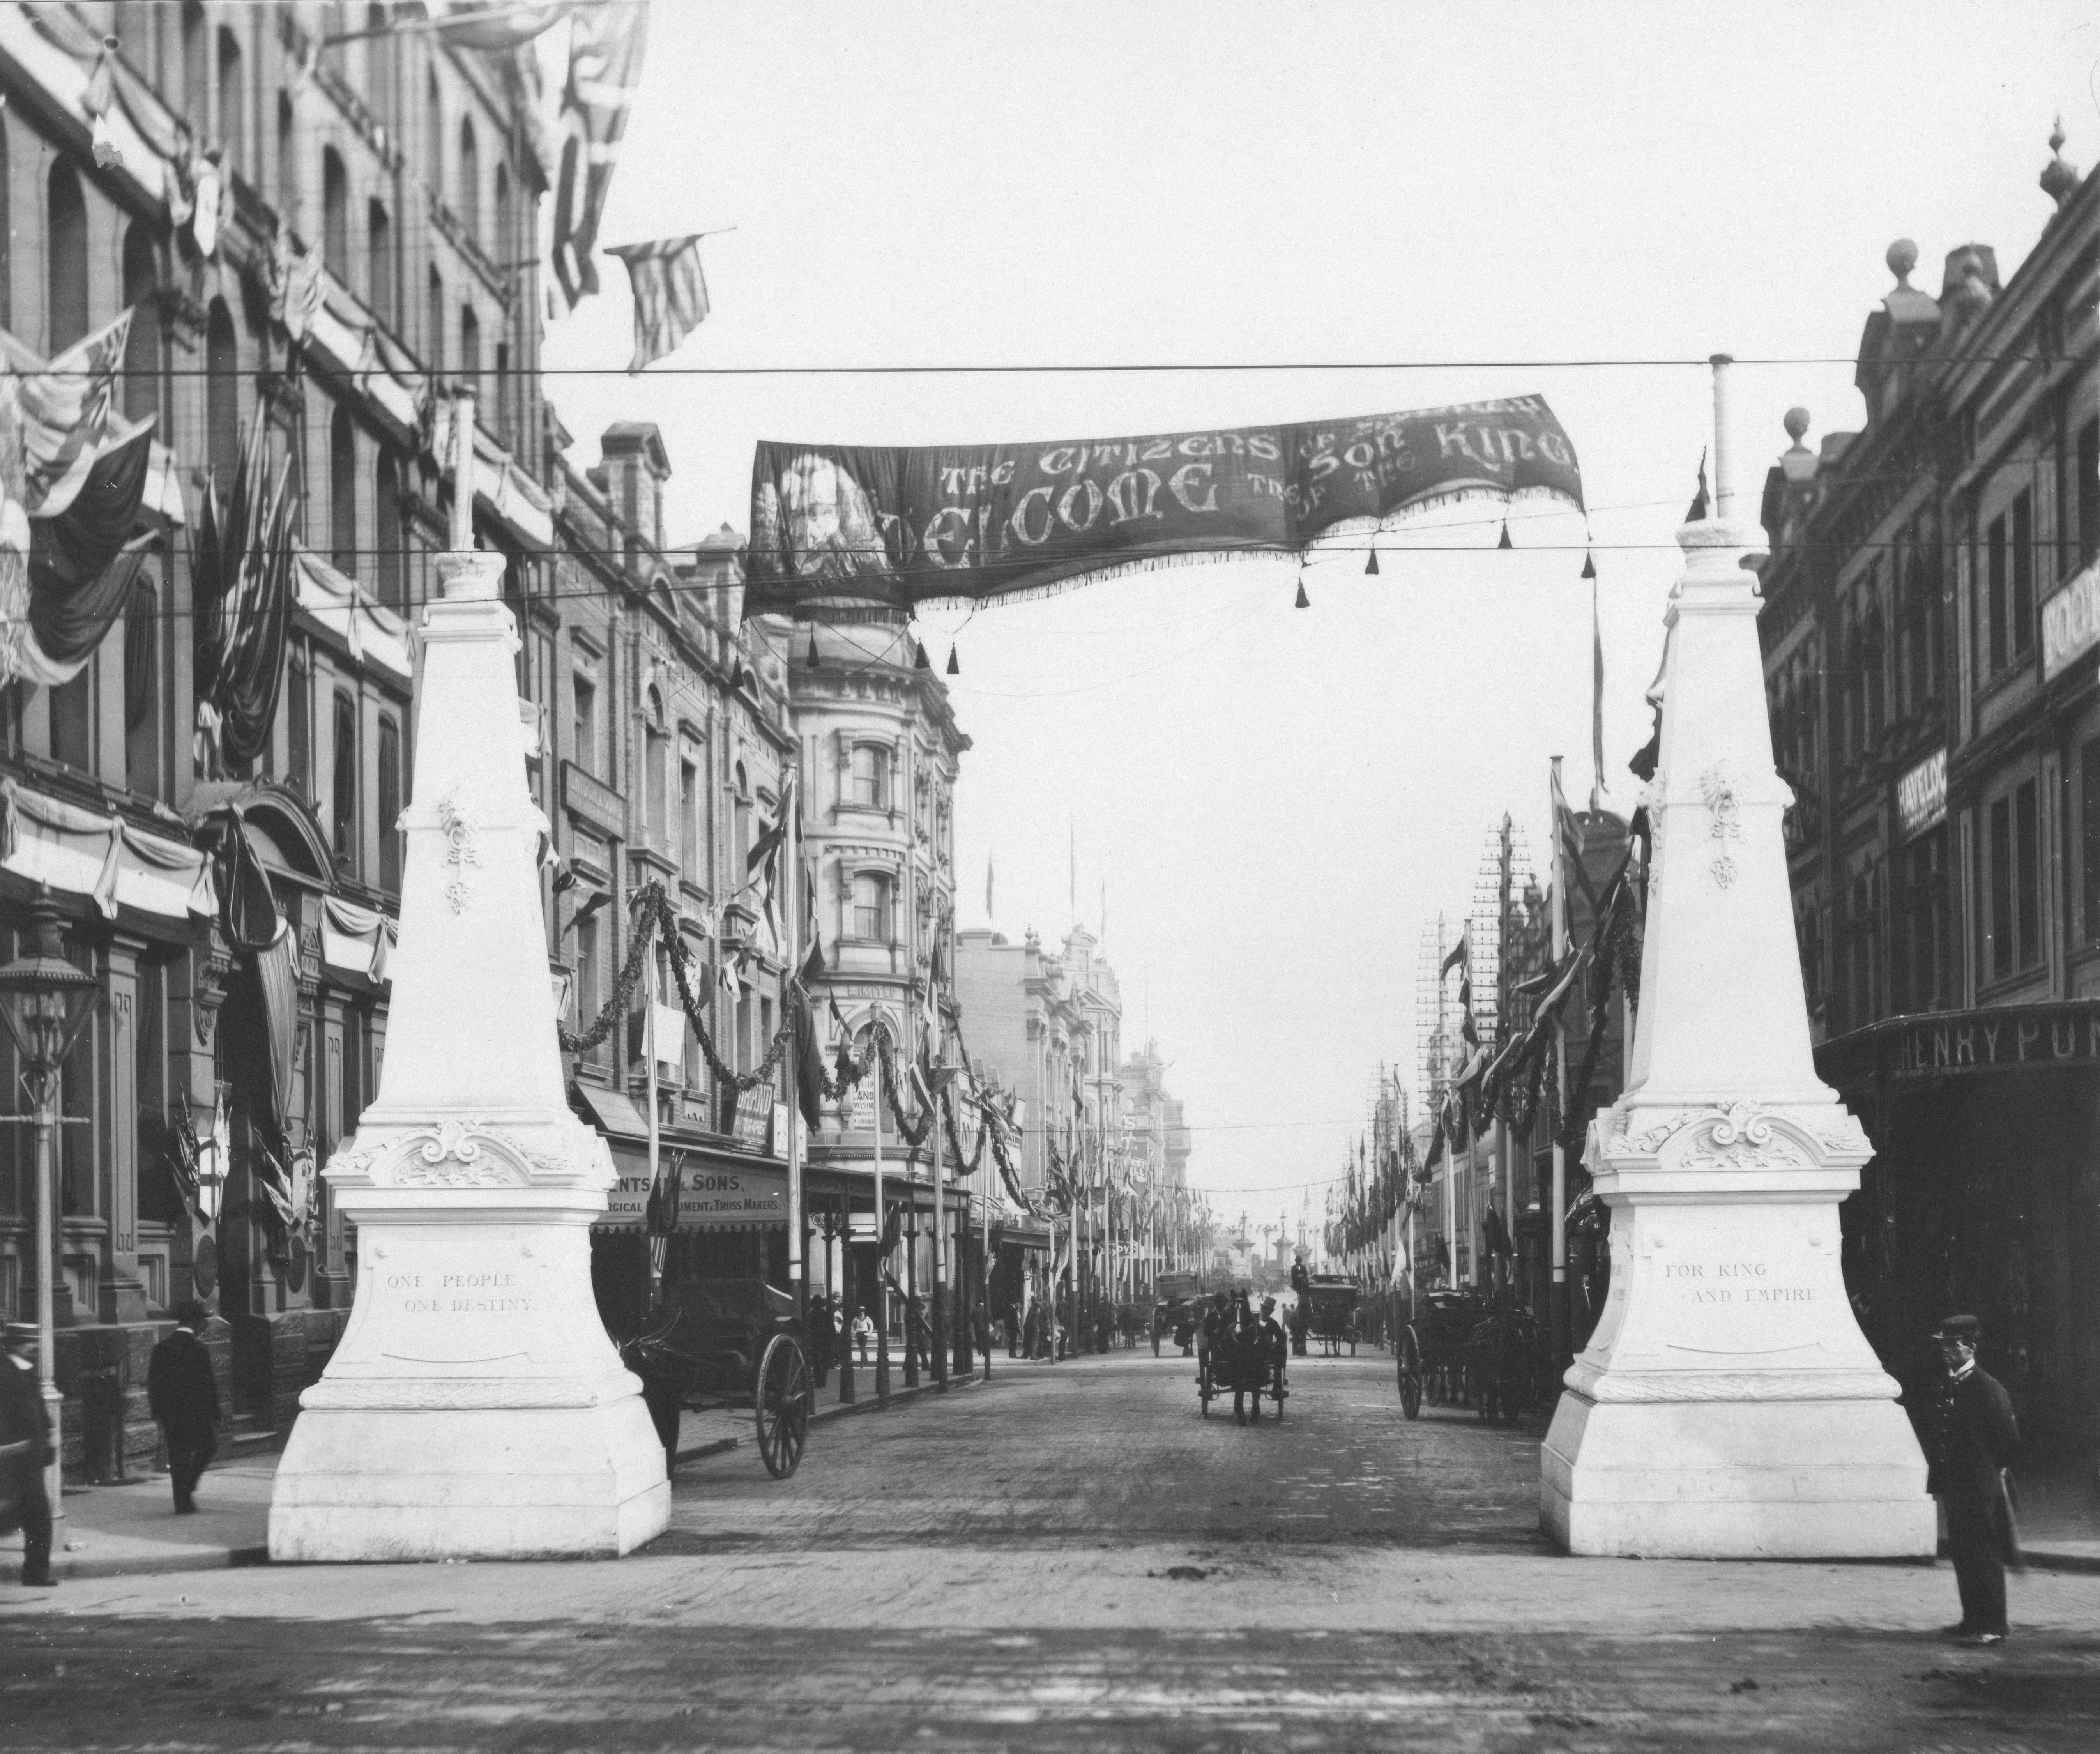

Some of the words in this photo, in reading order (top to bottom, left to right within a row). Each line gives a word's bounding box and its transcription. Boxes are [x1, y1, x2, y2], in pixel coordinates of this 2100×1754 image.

[1039, 433, 1280, 475] CITIZENS
[847, 985, 896, 997] LIMITED
[609, 1177, 650, 1192] NTS
[605, 1202, 643, 1212] RGICAL
[714, 1199, 742, 1211] TRUSS
[1665, 1264, 1704, 1277] FOR
[1718, 1263, 1767, 1277] KING
[387, 1275, 425, 1288] ONE
[443, 1273, 515, 1287] PEOPLE
[1692, 1290, 1731, 1303] AND
[1745, 1288, 1815, 1302] EMPIRE
[405, 1300, 441, 1312] ONE
[451, 1298, 533, 1312] DESTINY
